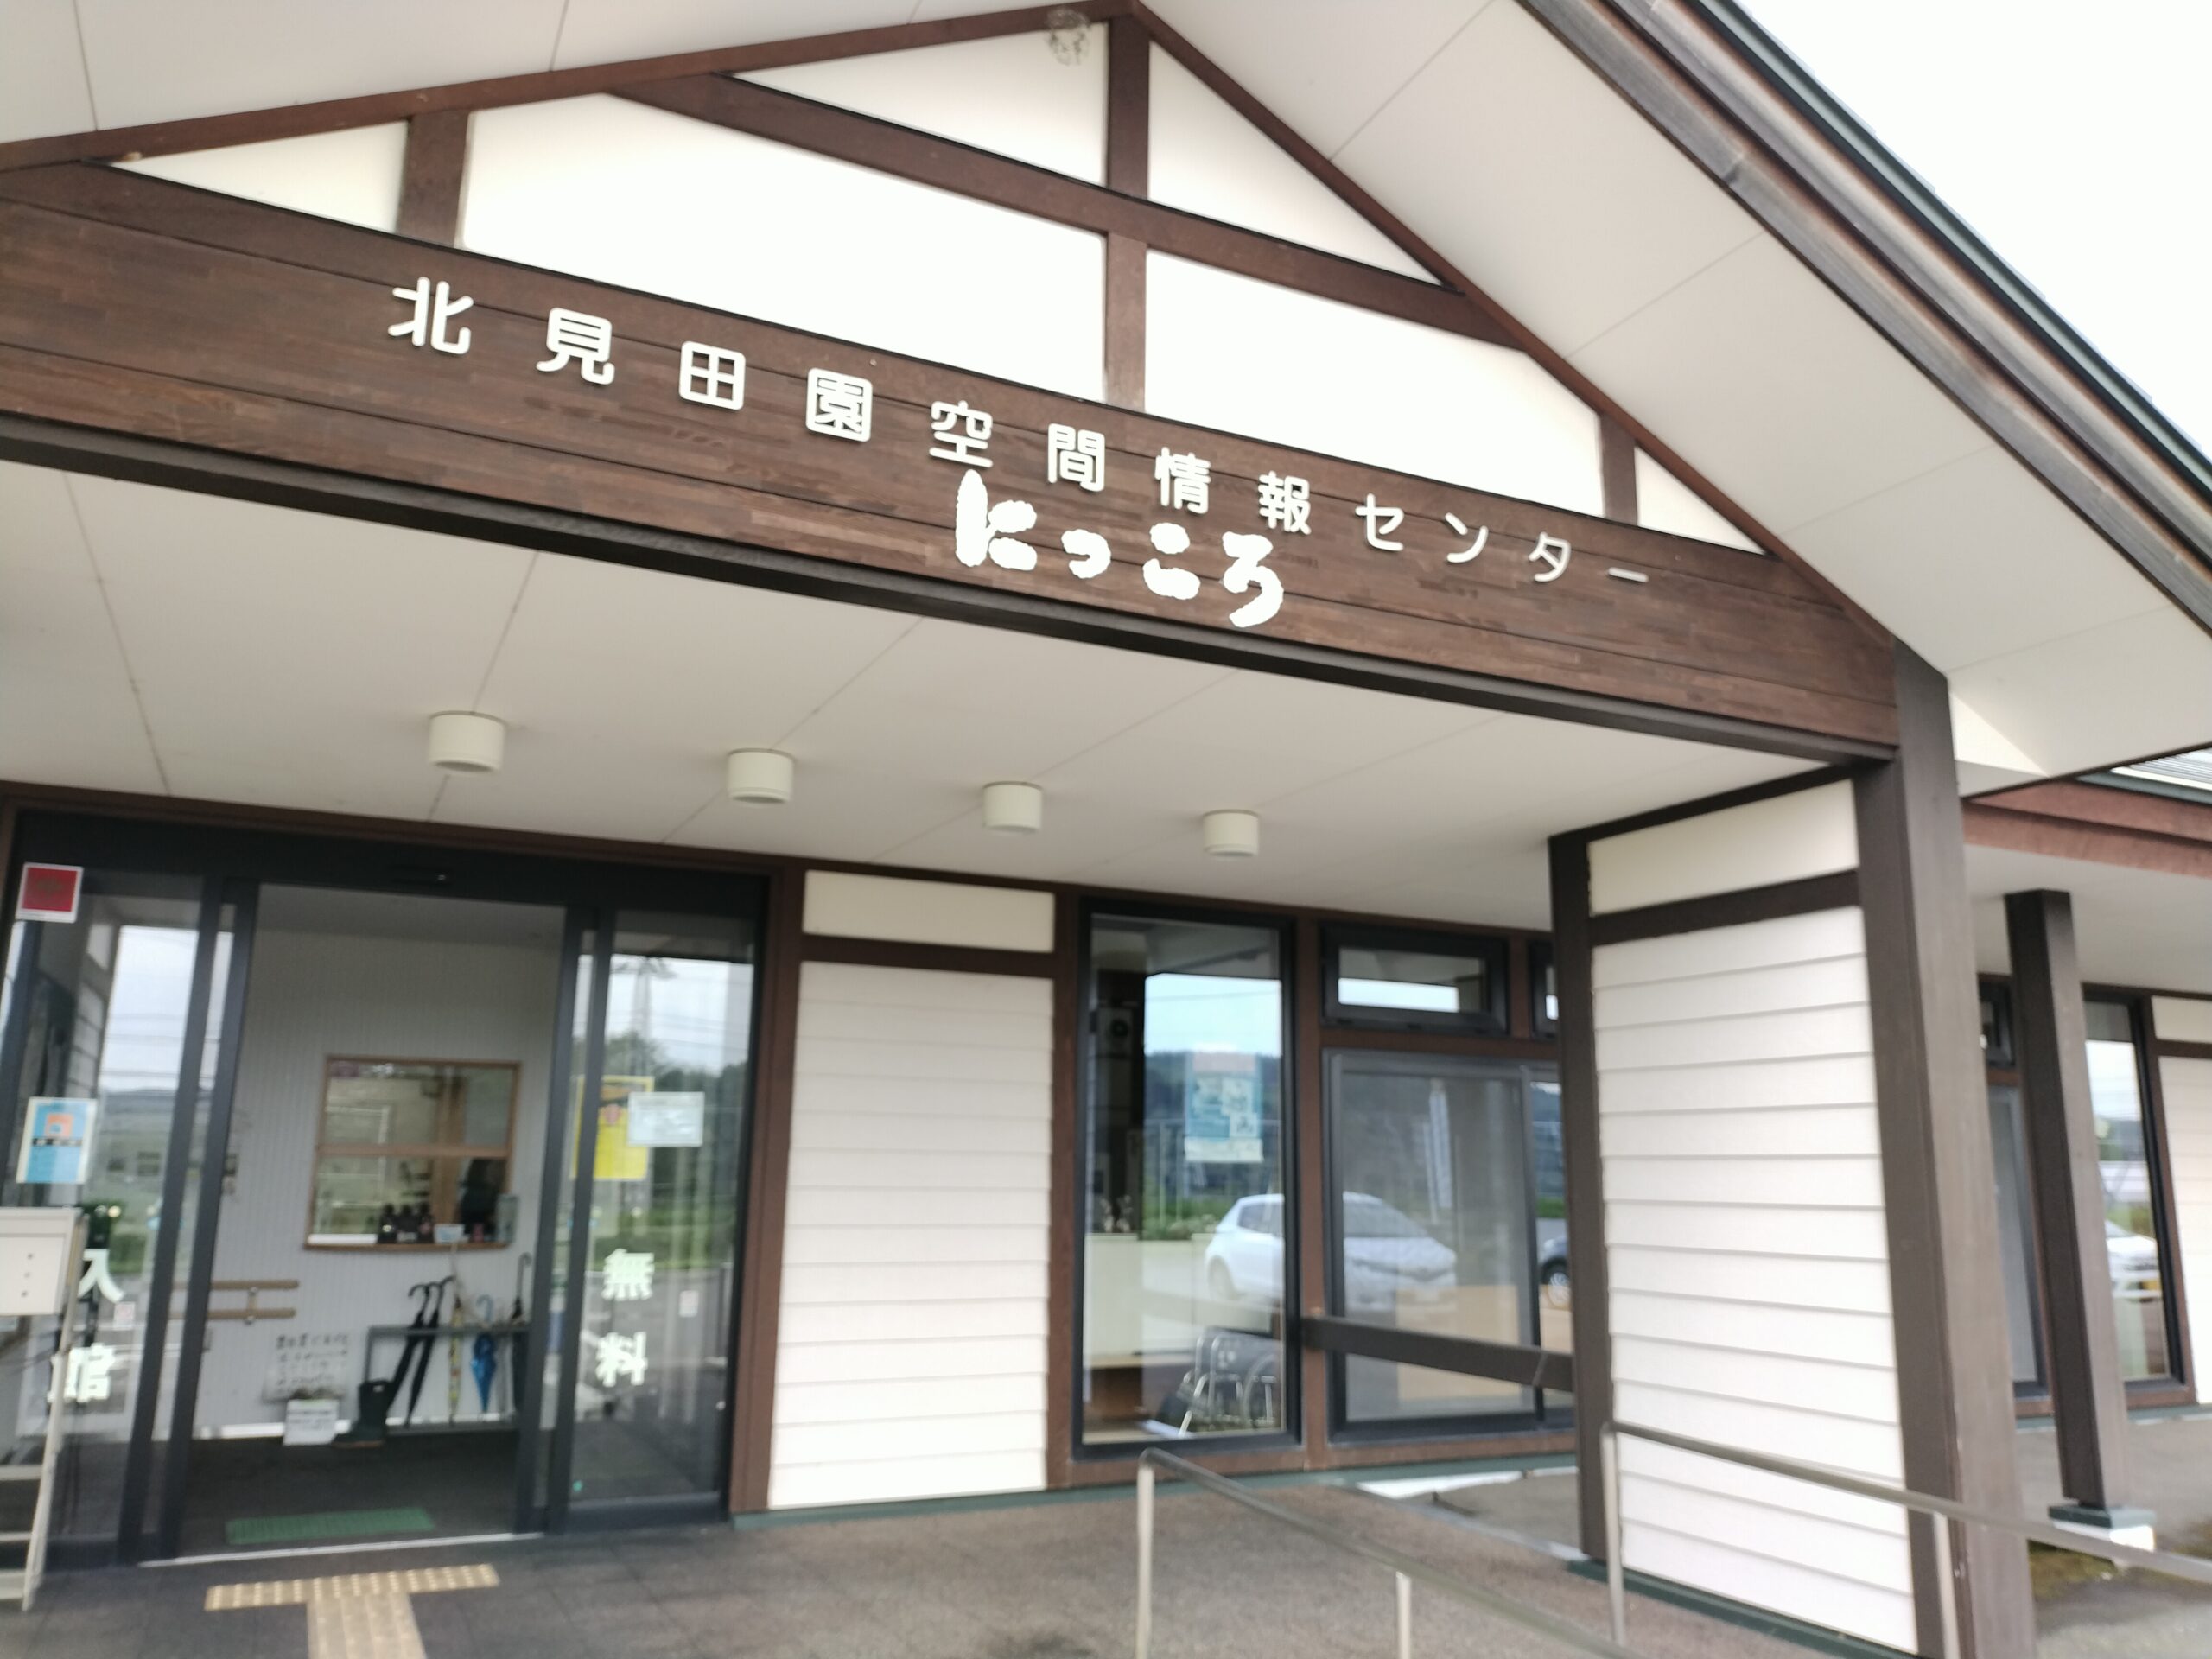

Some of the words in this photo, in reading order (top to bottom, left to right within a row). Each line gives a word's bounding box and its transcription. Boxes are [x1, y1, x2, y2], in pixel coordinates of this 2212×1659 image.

[387, 276, 1649, 584] 北見田園空間情報センター
[956, 469, 1284, 627] にっころ
[595, 1249, 655, 1387] 無料
